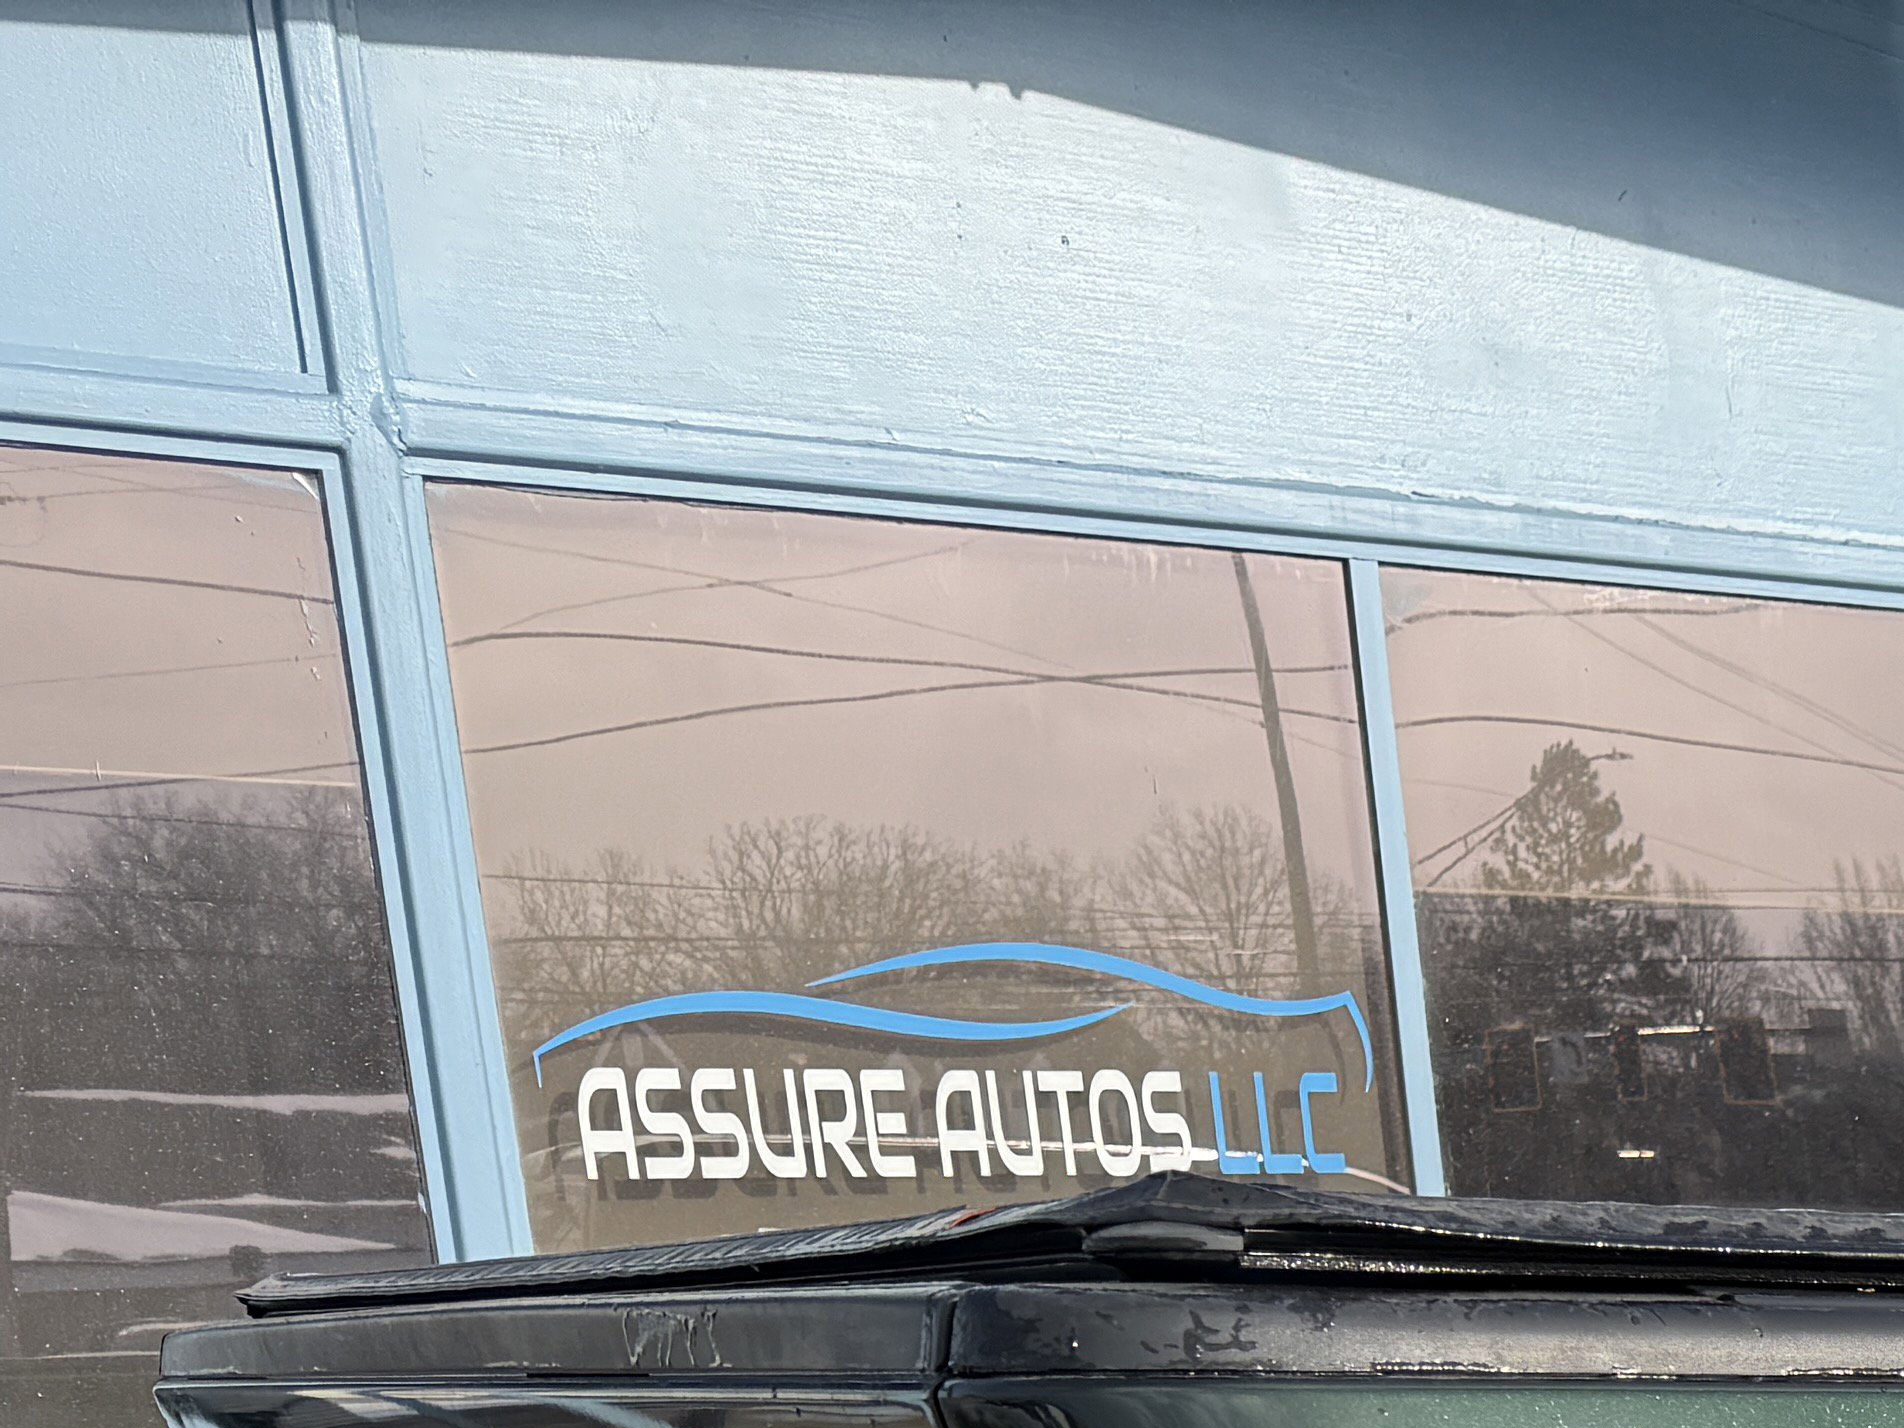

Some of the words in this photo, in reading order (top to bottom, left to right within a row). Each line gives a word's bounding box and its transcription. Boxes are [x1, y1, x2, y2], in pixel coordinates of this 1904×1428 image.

[576, 1066, 917, 1181] ASSURE
[935, 1068, 1192, 1179] AUTOS
[1207, 1070, 1347, 1176] LLC
